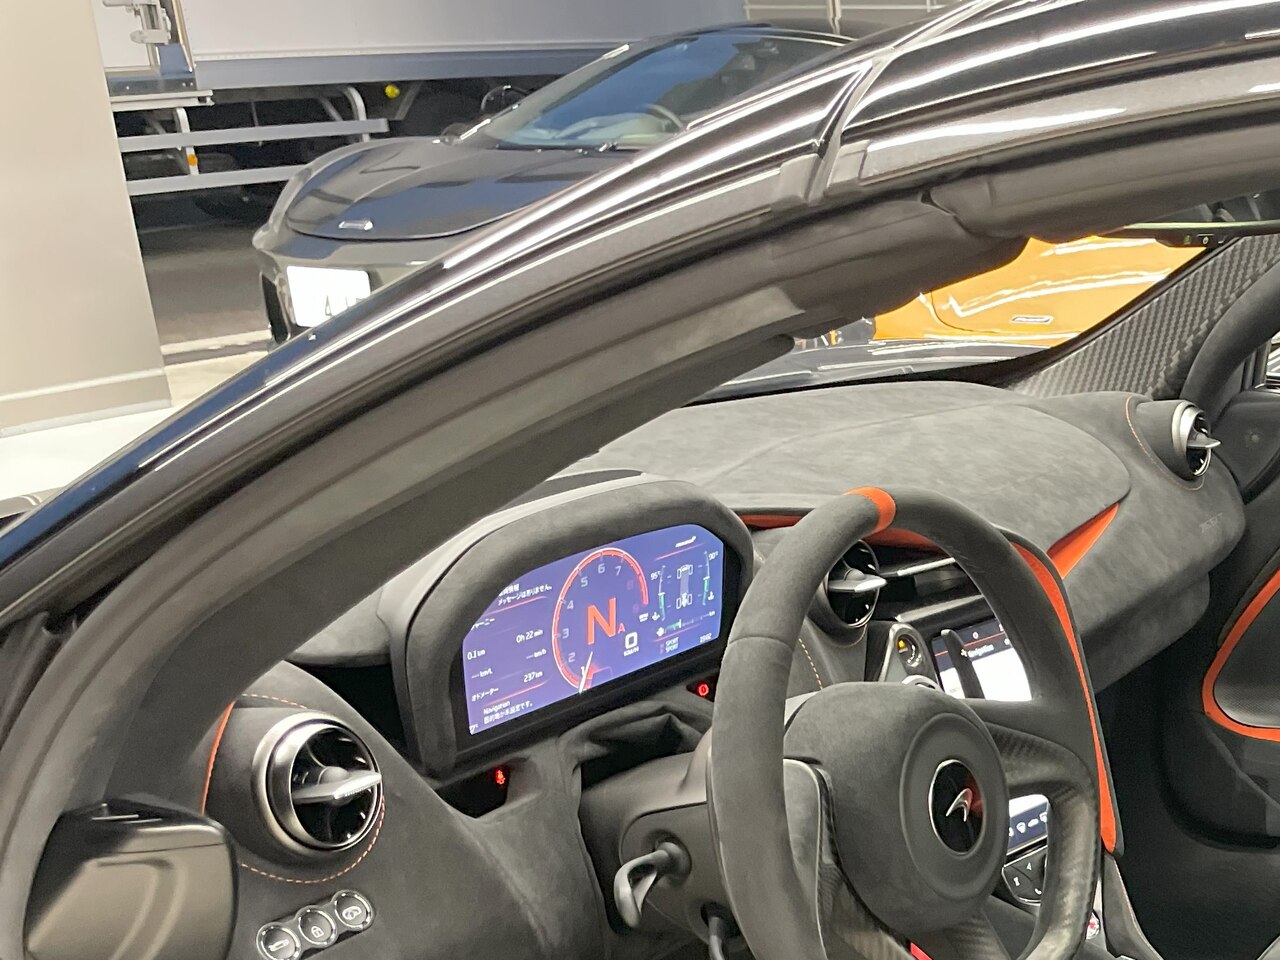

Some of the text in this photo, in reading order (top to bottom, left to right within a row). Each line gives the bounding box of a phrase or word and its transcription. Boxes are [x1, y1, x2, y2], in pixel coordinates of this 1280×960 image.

[597, 563, 605, 574] 6
[615, 565, 622, 576] 7
[581, 576, 588, 587] 5
[566, 599, 574, 610] 4
[587, 597, 617, 646] N
[562, 628, 570, 639] 3
[617, 622, 626, 635] A
[568, 652, 576, 663] 2
